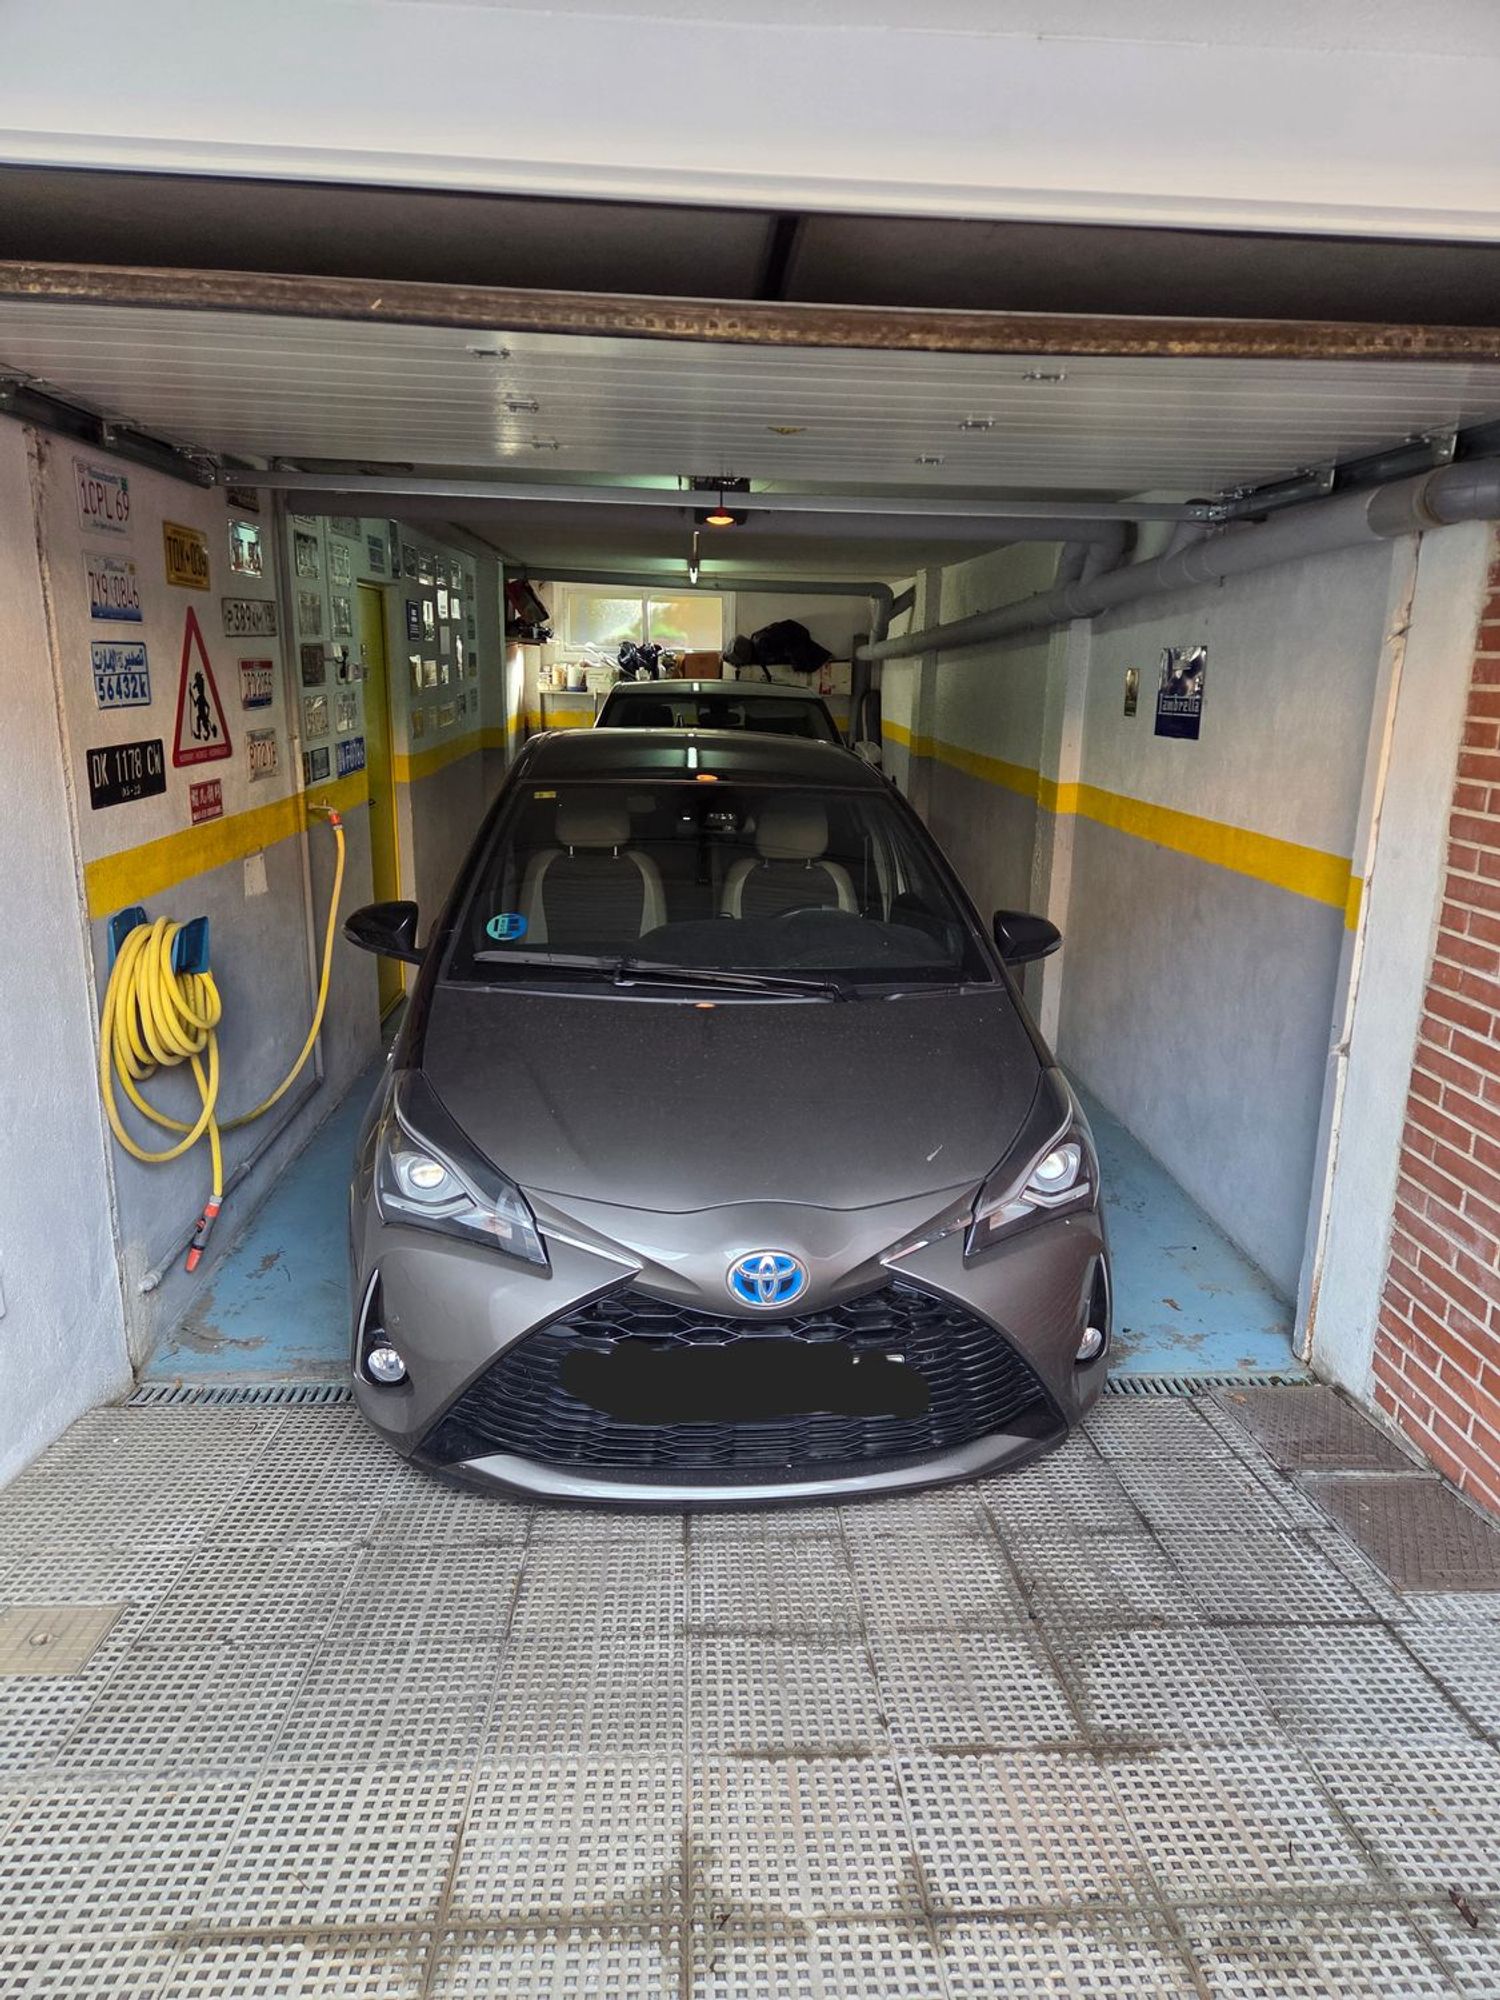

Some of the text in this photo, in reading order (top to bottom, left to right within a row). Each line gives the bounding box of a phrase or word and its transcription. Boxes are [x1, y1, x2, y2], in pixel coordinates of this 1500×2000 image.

[115, 489, 130, 522] 69
[92, 752, 110, 788] DK
[115, 747, 143, 783] 1178
[146, 743, 162, 776] CW
